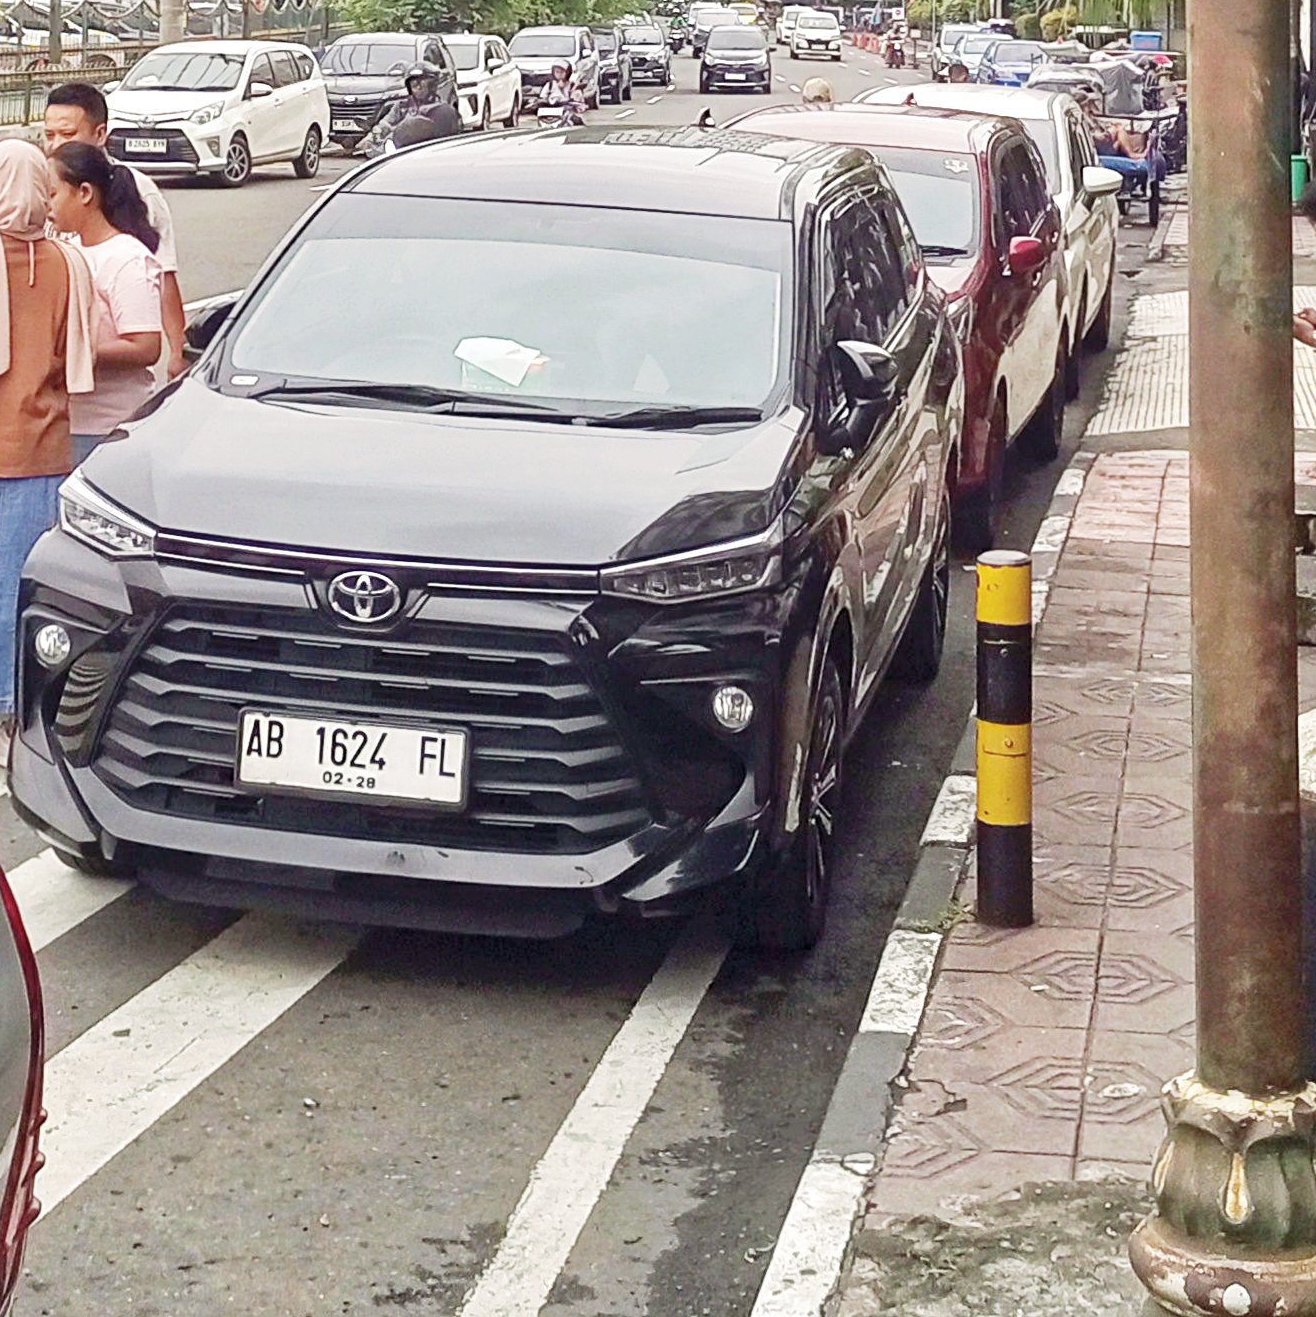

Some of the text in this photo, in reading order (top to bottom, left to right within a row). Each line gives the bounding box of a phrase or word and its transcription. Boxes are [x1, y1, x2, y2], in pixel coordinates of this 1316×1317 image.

[246, 719, 456, 778] AB 1624 FL
